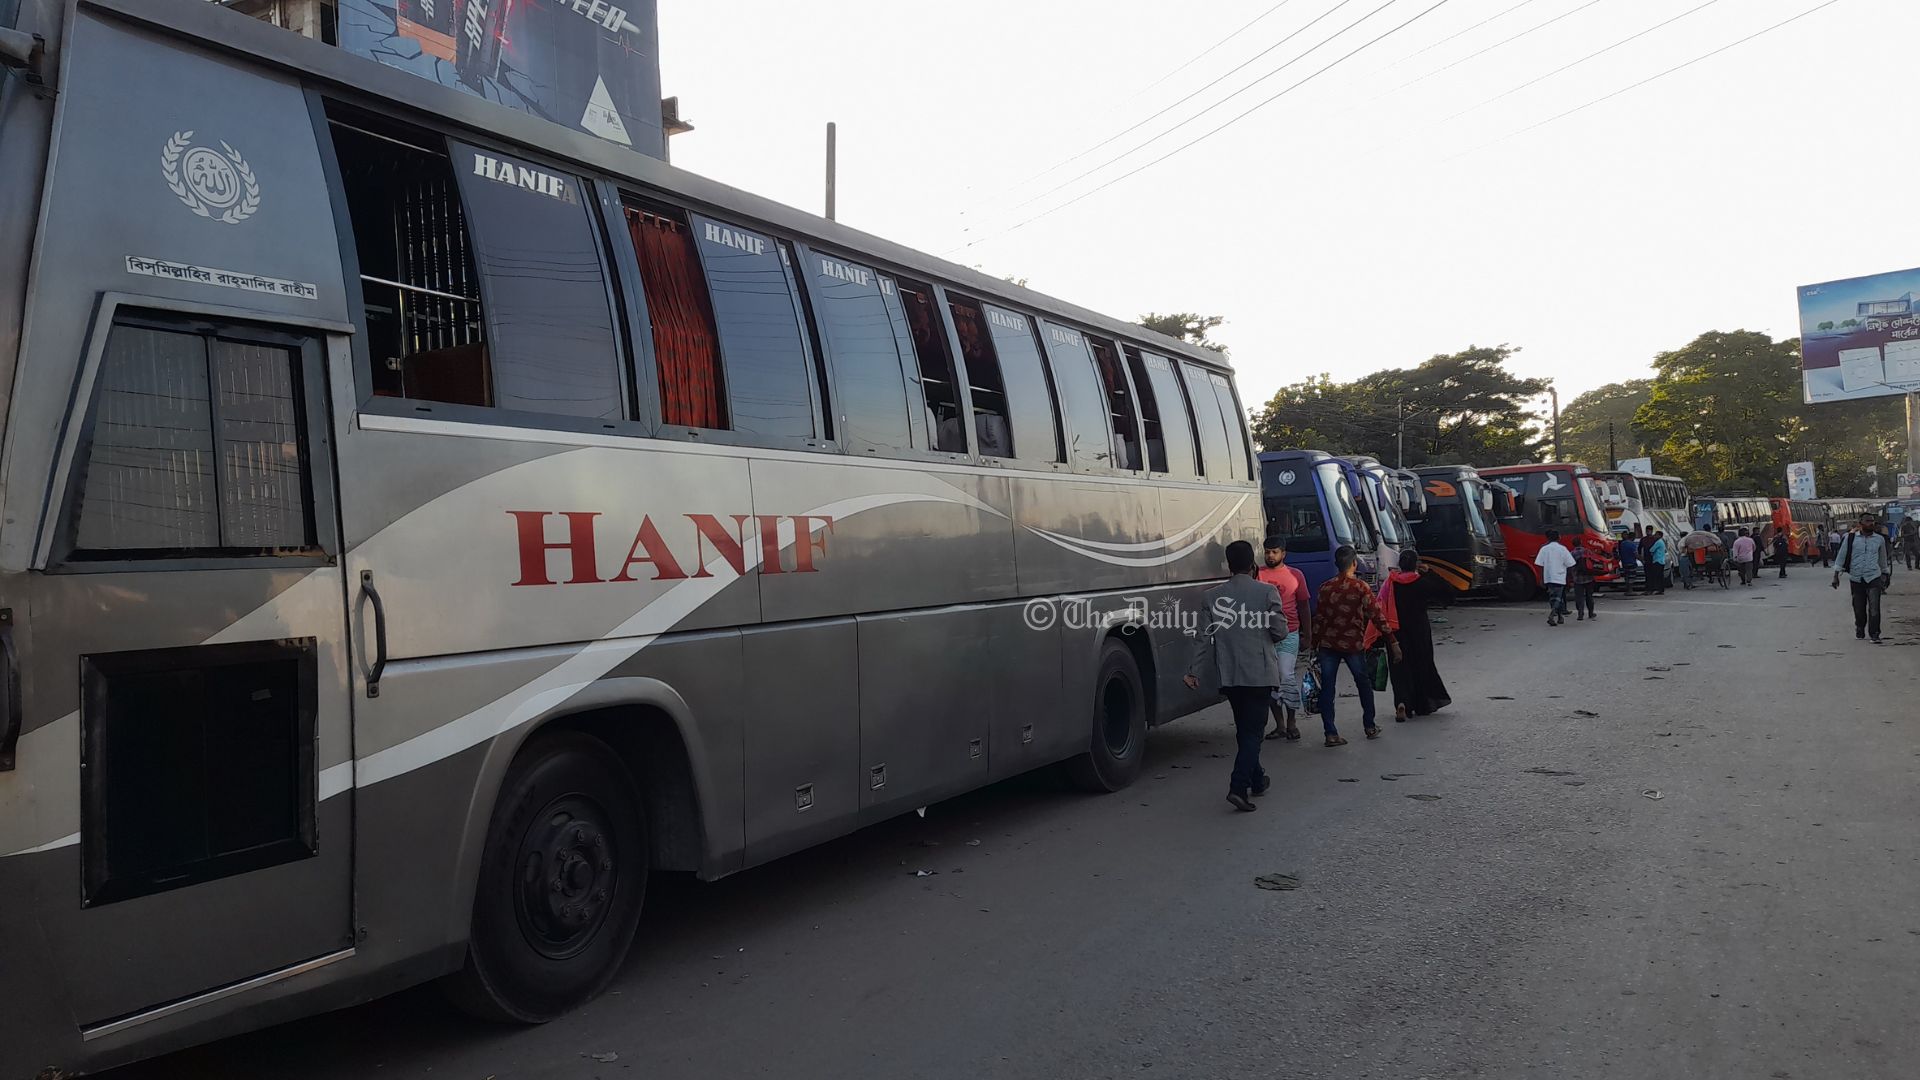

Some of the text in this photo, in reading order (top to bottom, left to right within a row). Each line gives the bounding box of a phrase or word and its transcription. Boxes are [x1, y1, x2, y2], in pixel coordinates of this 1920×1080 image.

[704, 222, 765, 256] HANIF
[821, 259, 869, 286] HANIF
[280, 281, 315, 298] রাহীম
[990, 311, 1023, 331] HANIF
[1051, 329, 1079, 347] HANIF
[505, 510, 835, 586] HANIF
